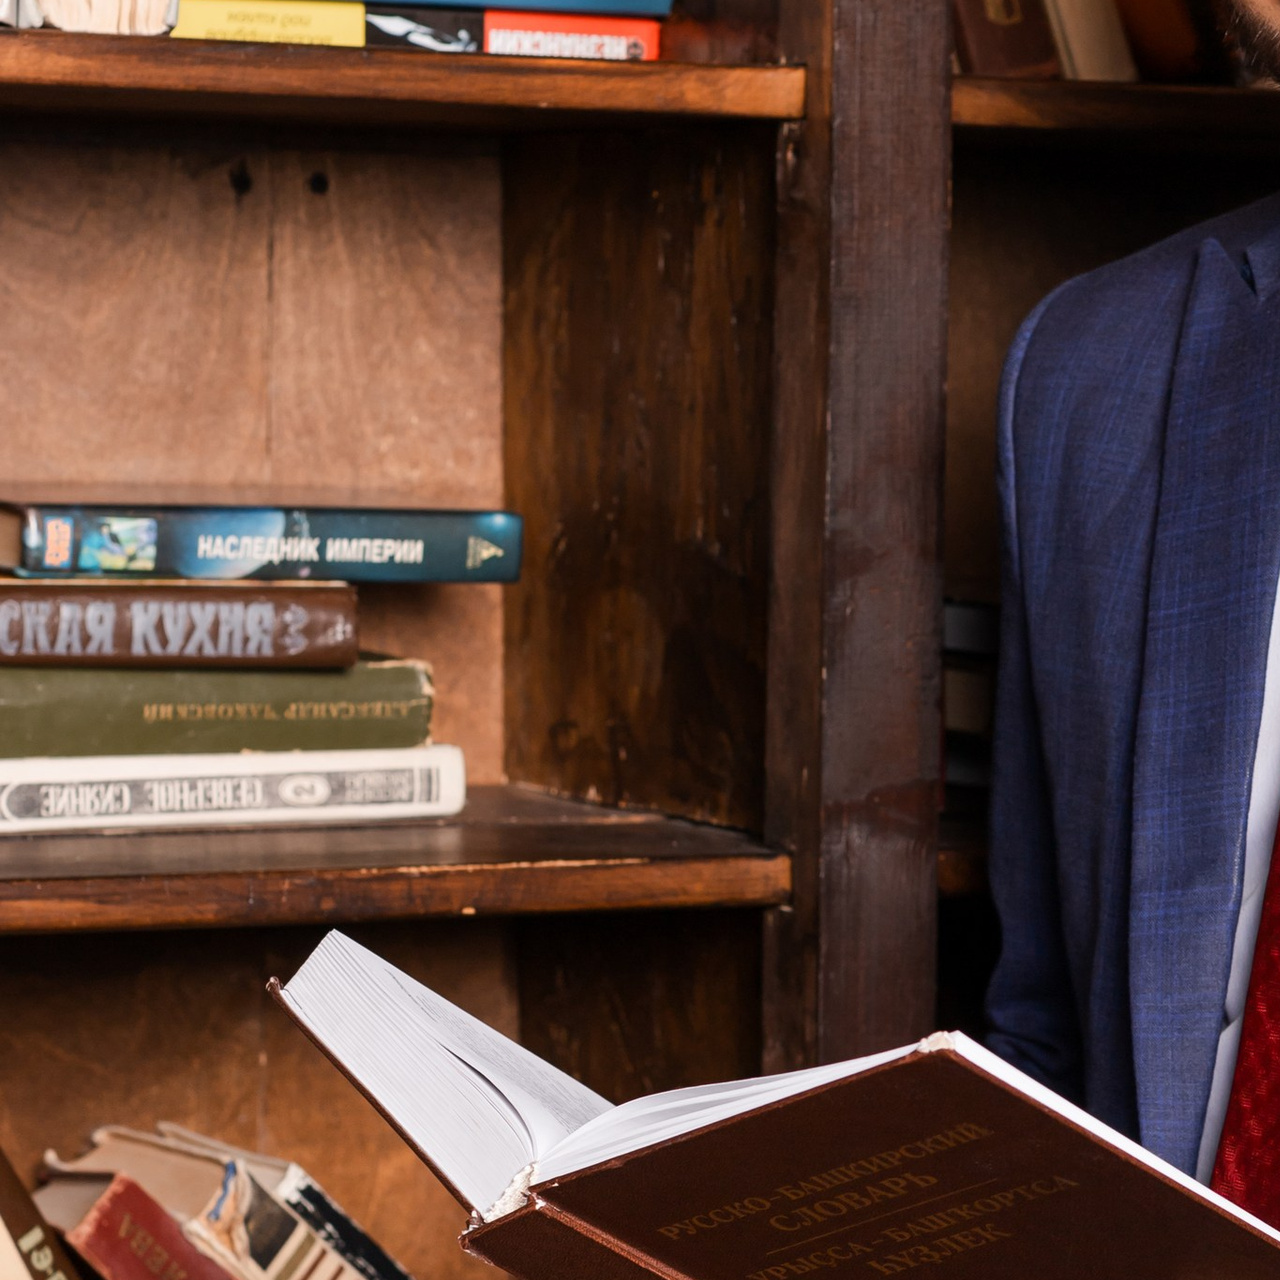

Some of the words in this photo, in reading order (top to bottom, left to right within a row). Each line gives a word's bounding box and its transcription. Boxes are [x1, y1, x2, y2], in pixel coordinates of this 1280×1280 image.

[197, 534, 321, 565] НАСЛЕДНИК
[325, 536, 425, 564] ИМПЕРИИ
[129, 601, 276, 658] КУХНЯ
[39, 782, 132, 817] СИЯНИЕ
[147, 776, 264, 813] СЕВЕРНОЕ
[658, 1120, 994, 1241] РУССКО-БАШКИРСКИЙ
[768, 1170, 939, 1234] СЛОВАРЬ
